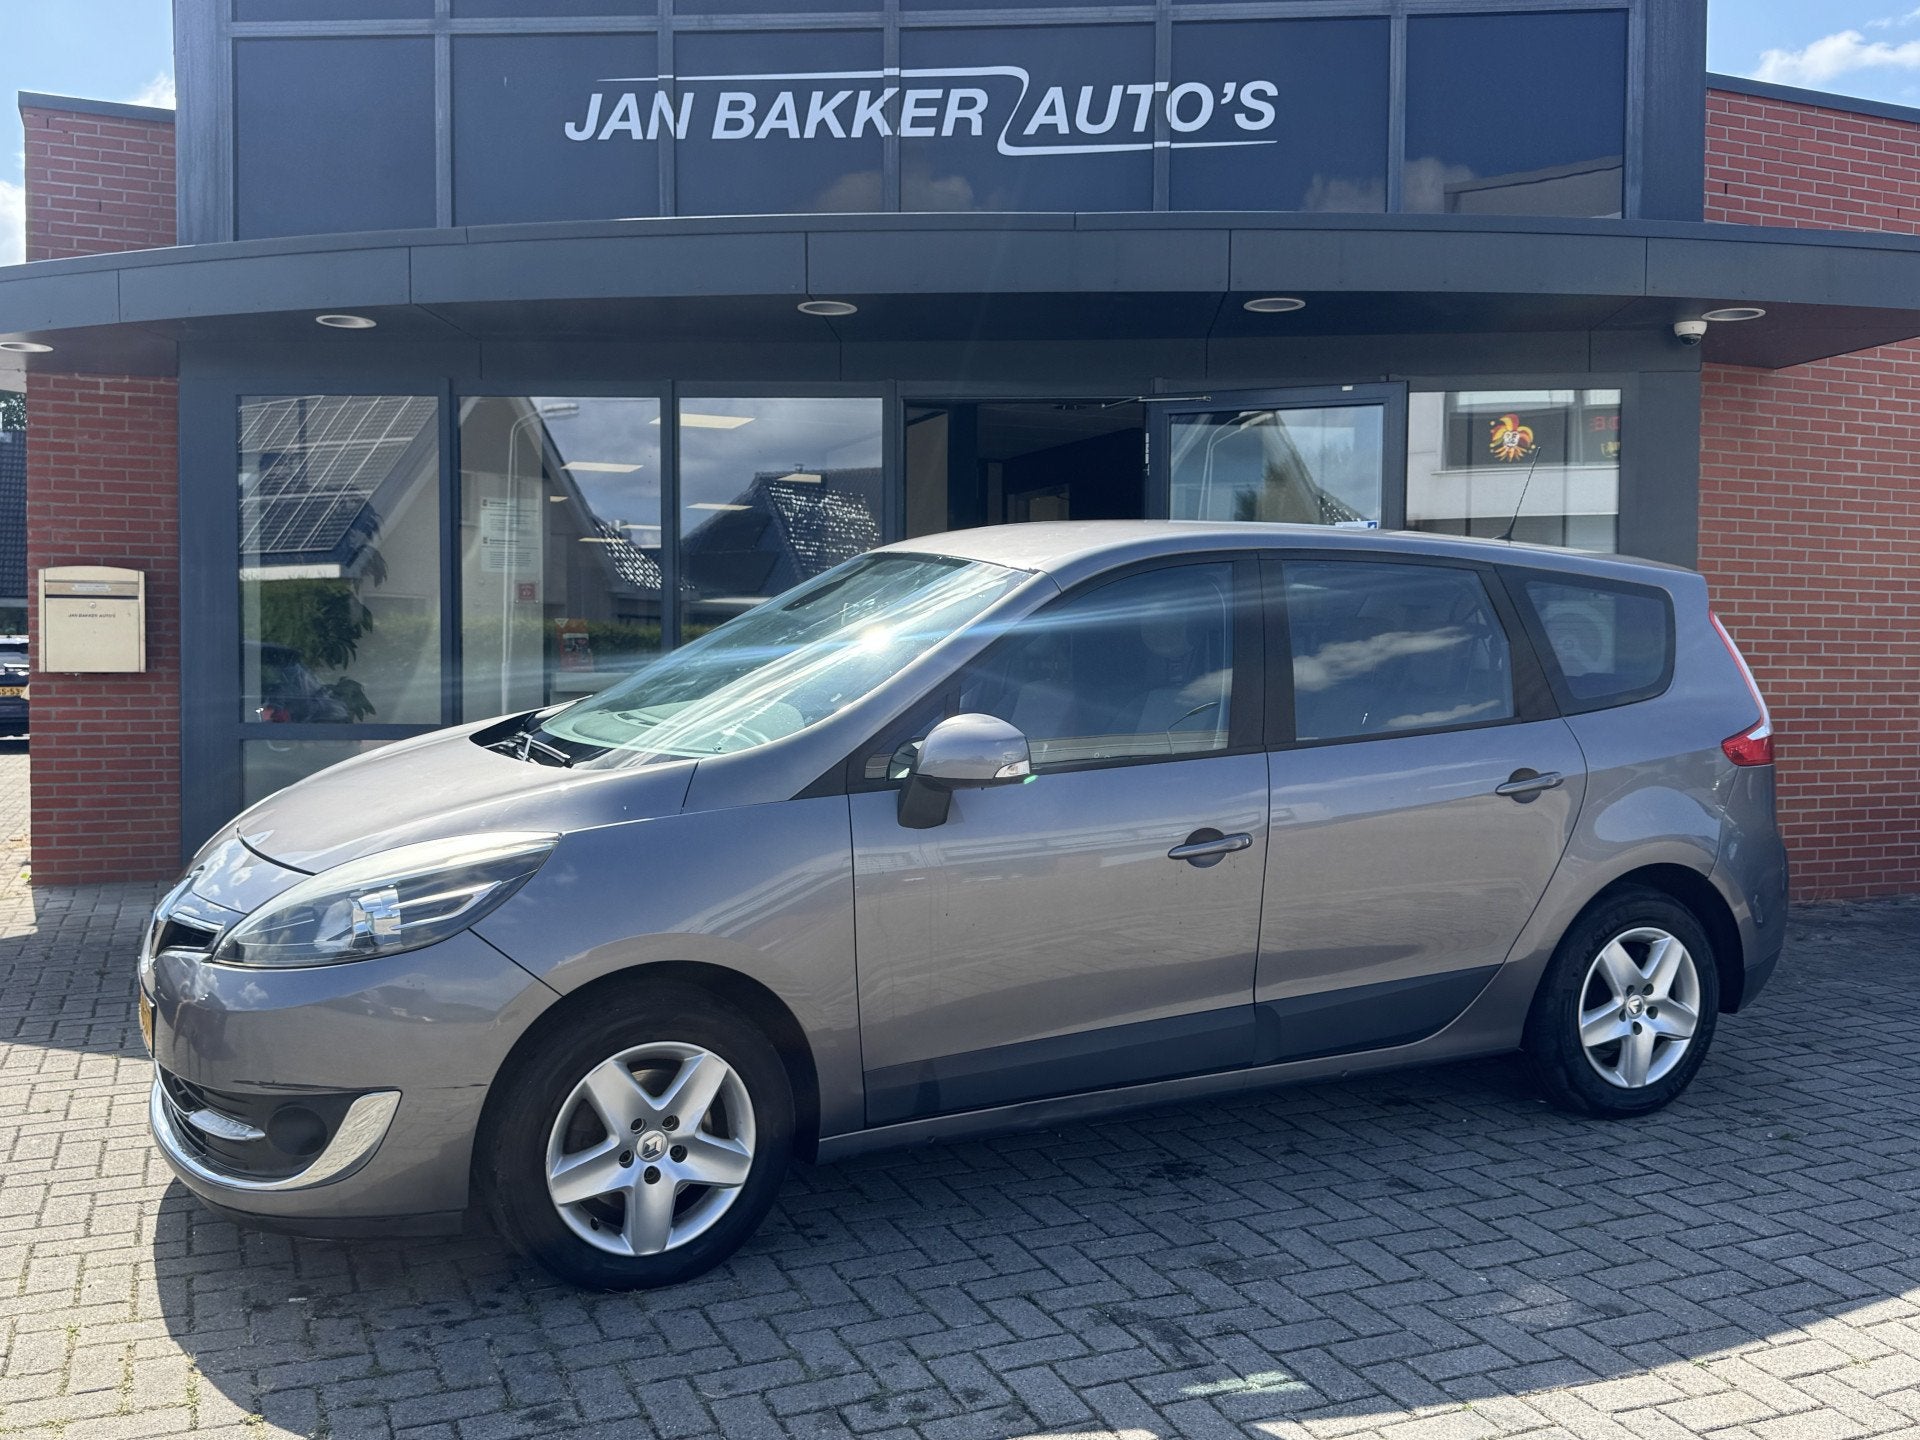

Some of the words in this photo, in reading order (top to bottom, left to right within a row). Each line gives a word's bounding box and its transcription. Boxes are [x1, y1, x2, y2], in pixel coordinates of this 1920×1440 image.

[564, 90, 695, 141] JAN
[711, 87, 989, 140] BAKKER
[1022, 80, 1279, 136] AUTO'S
